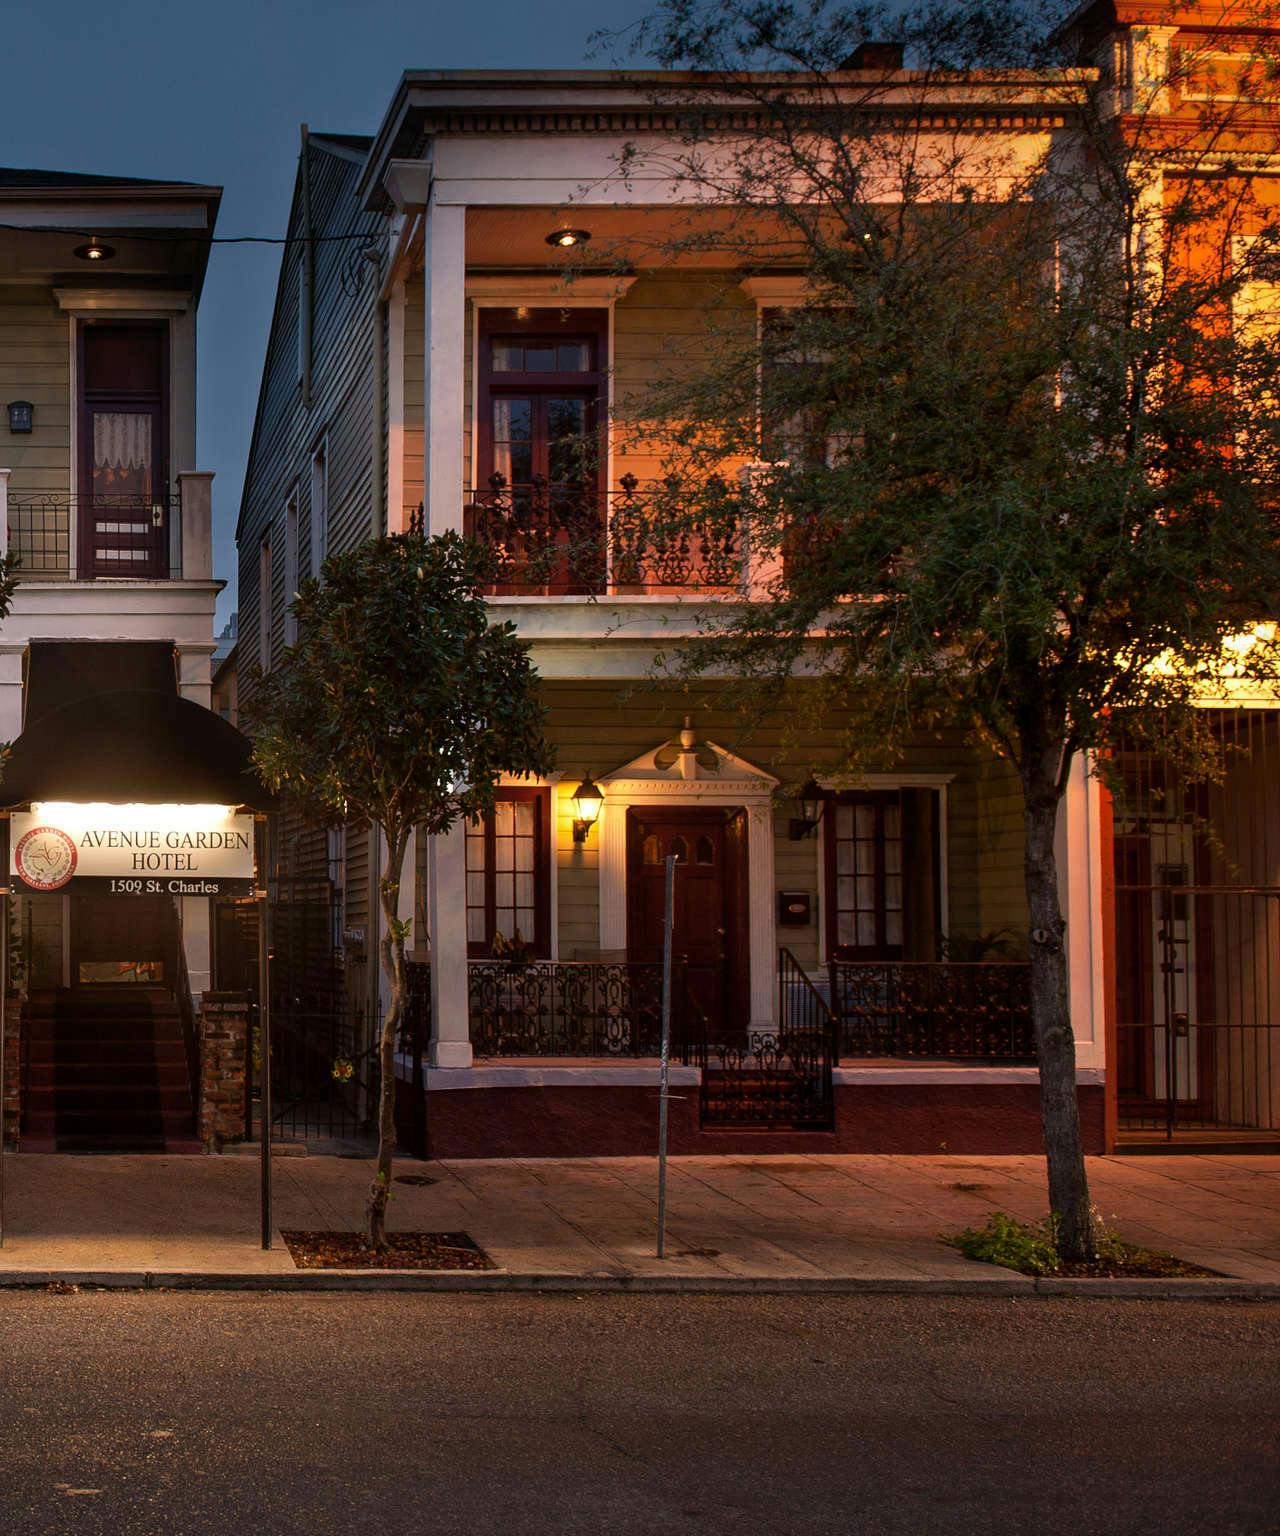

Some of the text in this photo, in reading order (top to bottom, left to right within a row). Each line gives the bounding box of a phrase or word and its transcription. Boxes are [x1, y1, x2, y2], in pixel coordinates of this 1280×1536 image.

[80, 830, 250, 851] AVENUE GARDEN
[131, 852, 199, 872] HOTEL
[109, 880, 220, 895] 1509 St. Charles
